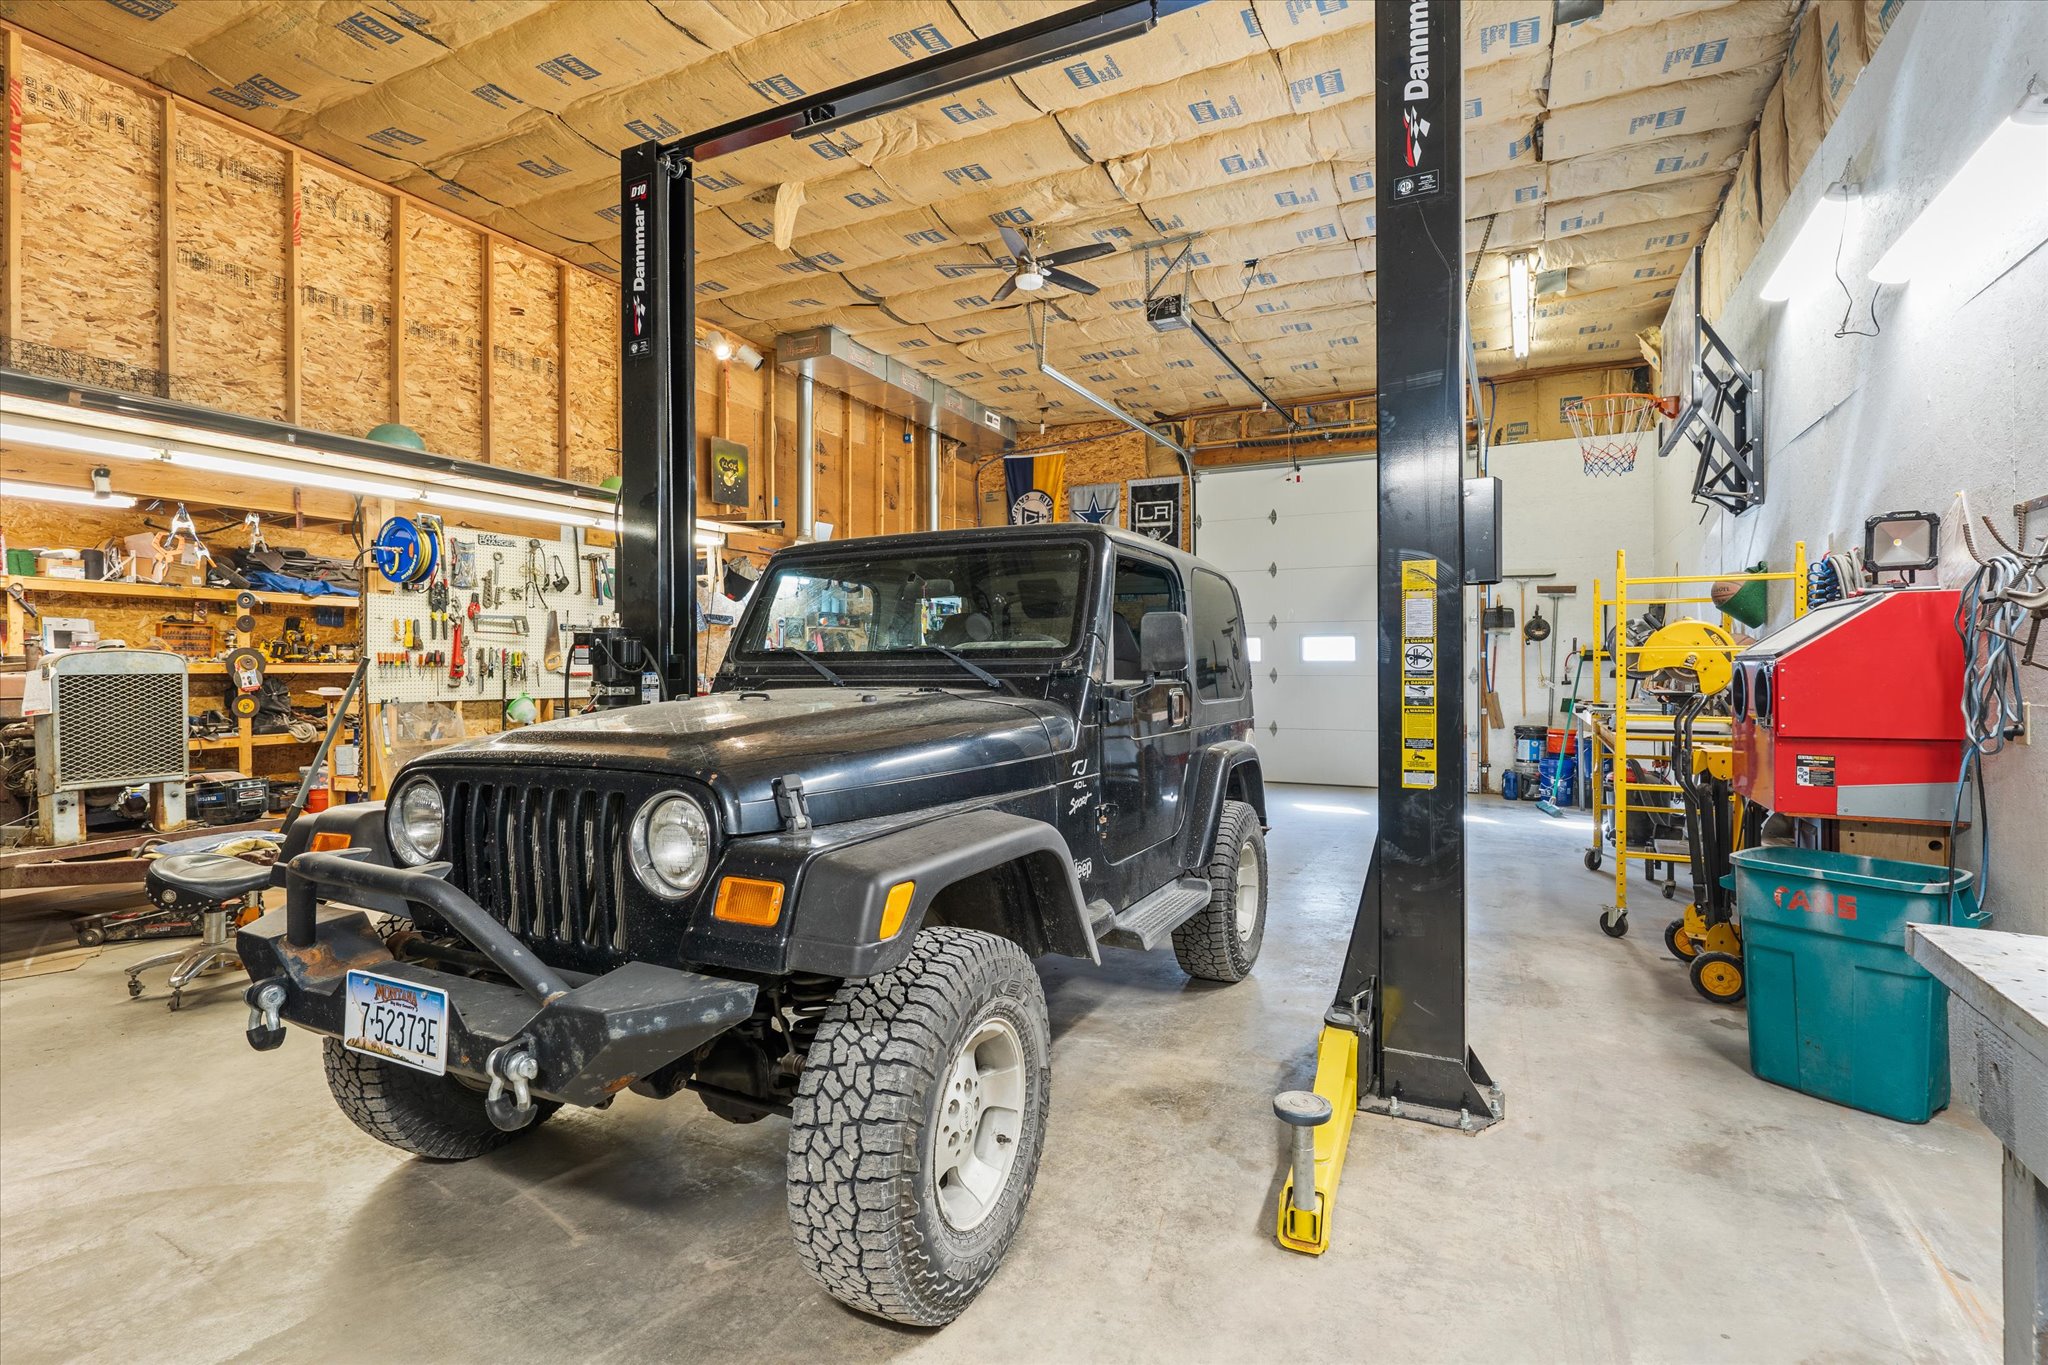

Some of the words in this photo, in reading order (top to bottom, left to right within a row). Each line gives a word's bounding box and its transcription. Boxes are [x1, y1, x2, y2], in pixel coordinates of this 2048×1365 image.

[349, 12, 402, 44] KNAUF
[914, 25, 951, 53] KNAUF
[1513, 18, 1537, 47] KNAUF
[1404, 0, 1429, 101] Dannm
[1695, 40, 1724, 66] KNAUF
[555, 55, 599, 80] KNAUF
[1068, 63, 1097, 87] KNAUF
[252, 75, 299, 100] KNAUF
[766, 76, 804, 99] KNAUF
[1318, 71, 1342, 96] KNAUF
[631, 183, 647, 198] D10
[633, 207, 646, 292] Dannmar
[1507, 423, 1528, 436] KNAUF
[1140, 506, 1169, 520] LA
[1072, 759, 1088, 776] TJ
[1068, 791, 1092, 815] Sport
[374, 982, 419, 1008] MONTANA
